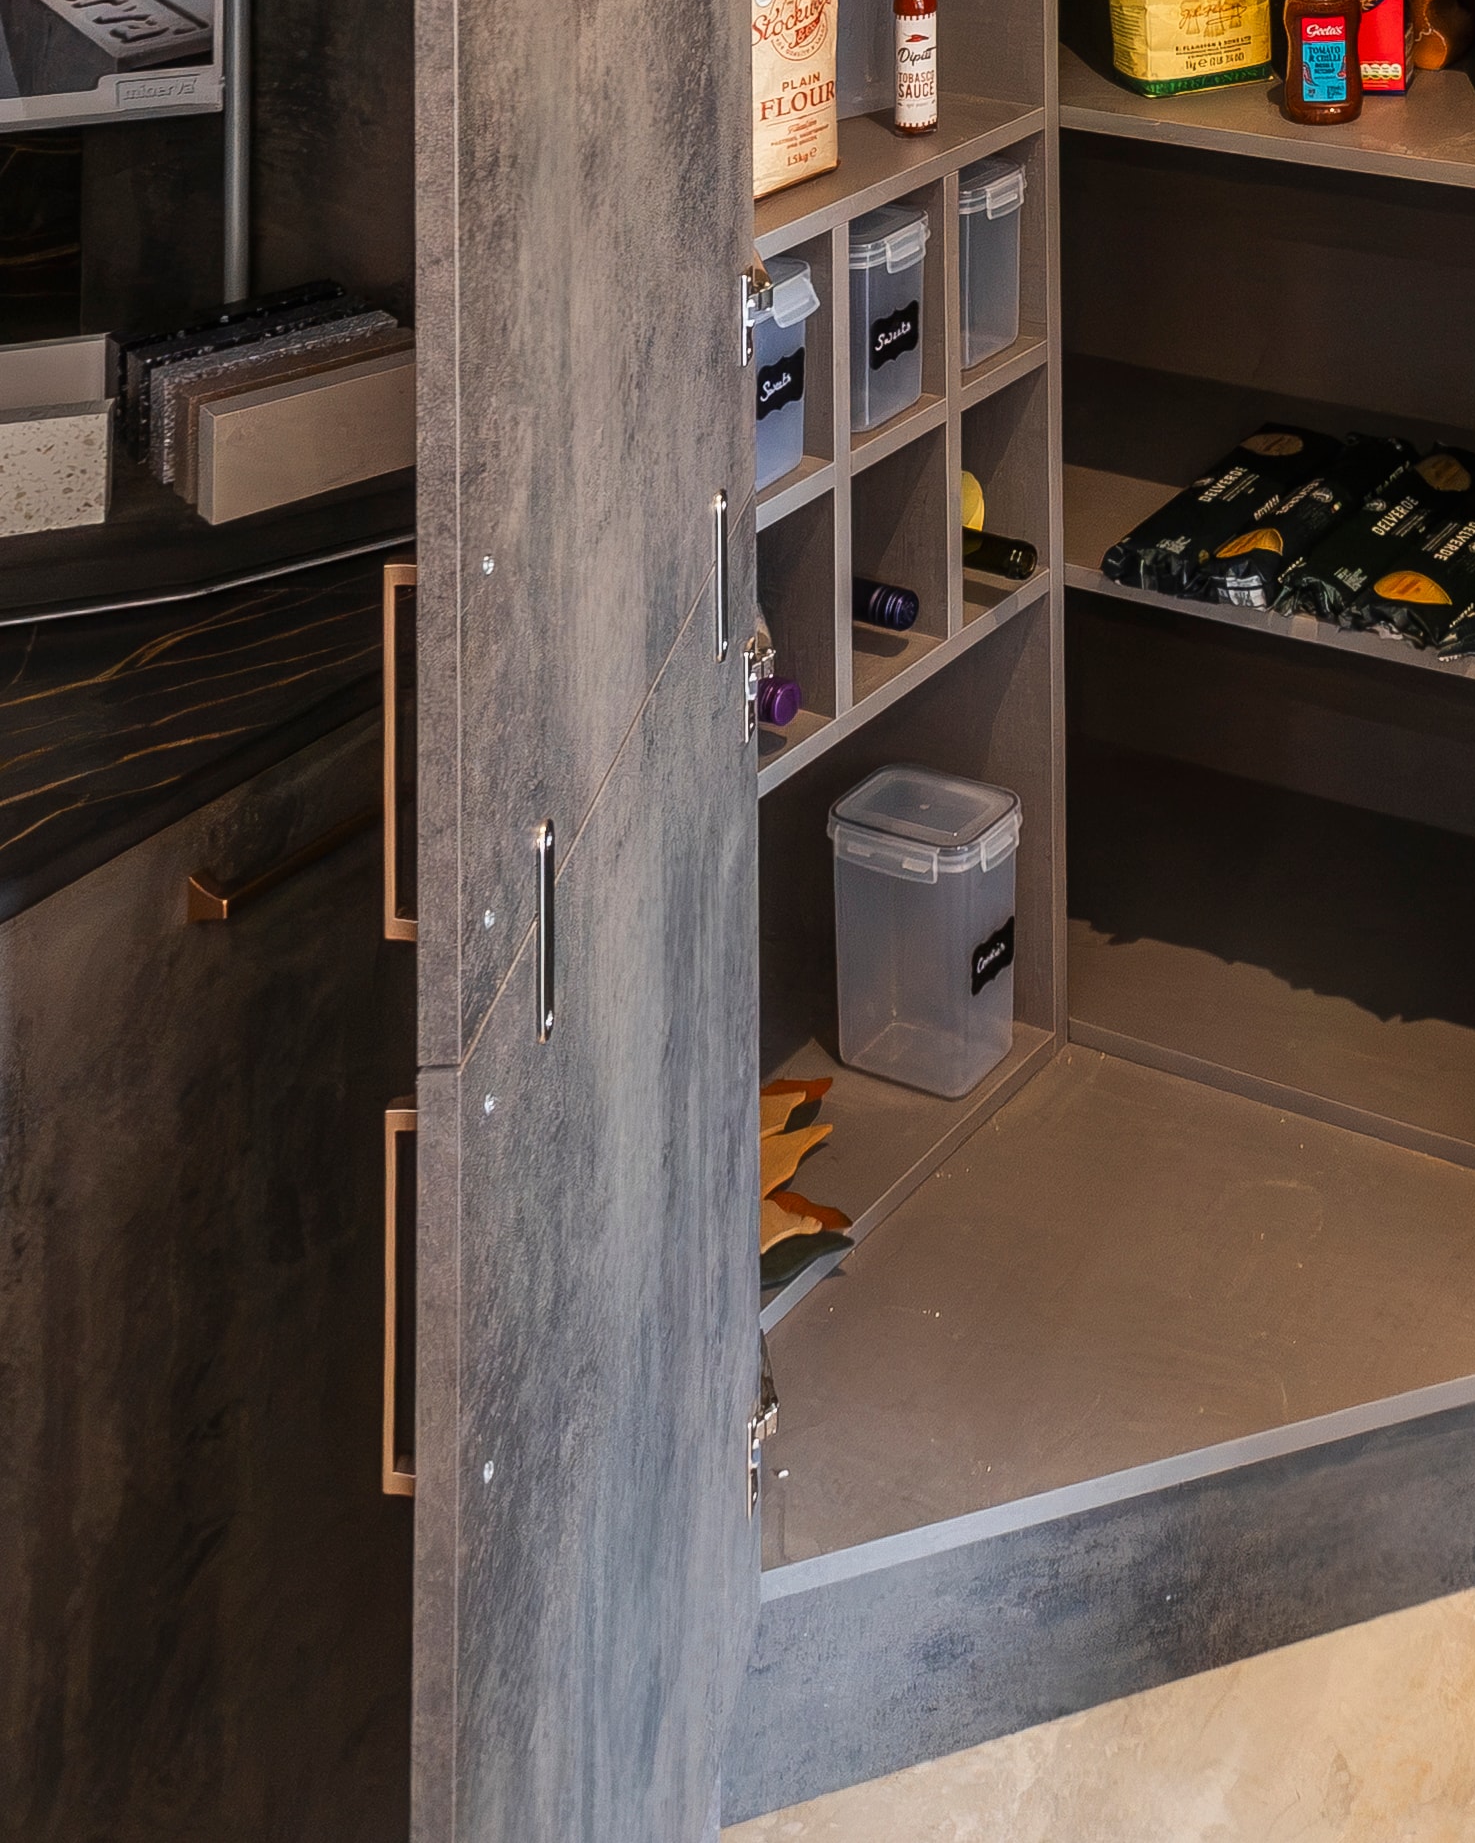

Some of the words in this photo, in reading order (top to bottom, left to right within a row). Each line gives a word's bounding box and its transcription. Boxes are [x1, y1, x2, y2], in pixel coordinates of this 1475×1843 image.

[1308, 45, 1341, 55] TOMATO
[782, 72, 820, 92] PLAIN
[898, 81, 935, 99] SAUCE
[759, 80, 835, 121] FLOUR
[875, 321, 911, 351] Sweets
[760, 372, 791, 402] Sweets
[1198, 466, 1248, 503] DELVERDE
[1371, 496, 1419, 536] DELVERDE
